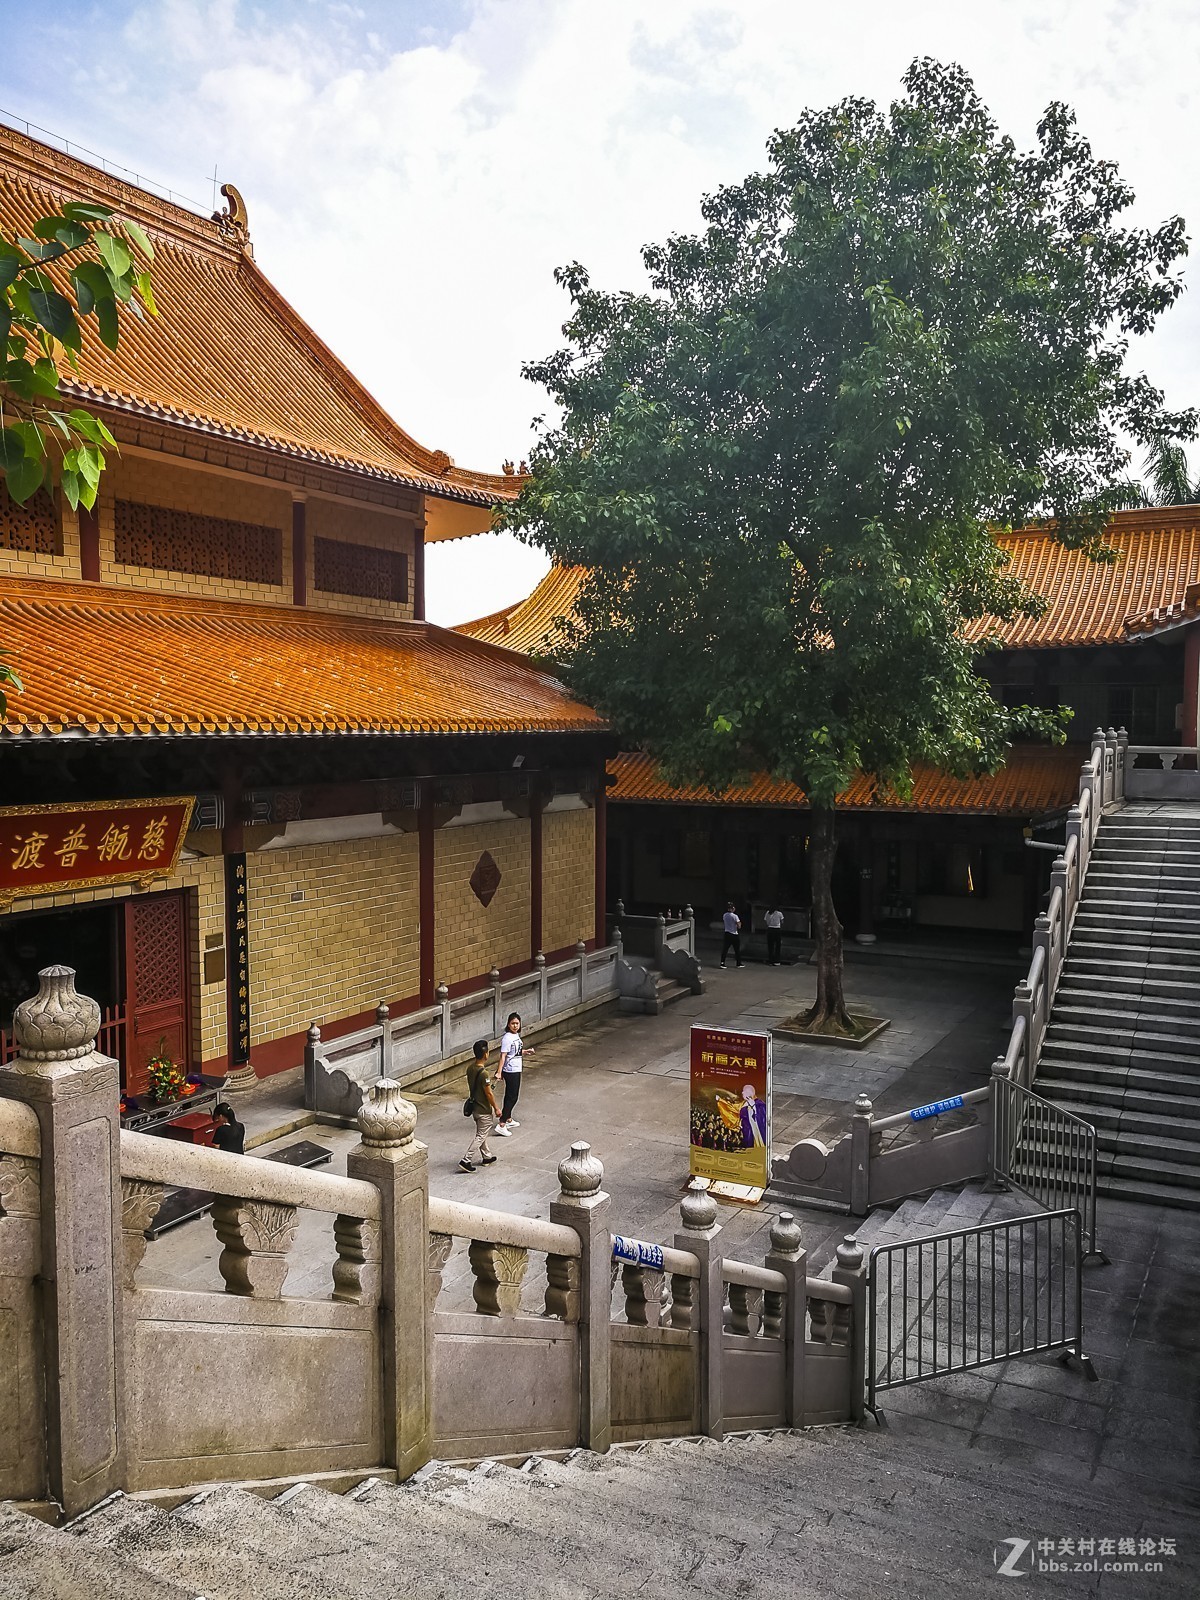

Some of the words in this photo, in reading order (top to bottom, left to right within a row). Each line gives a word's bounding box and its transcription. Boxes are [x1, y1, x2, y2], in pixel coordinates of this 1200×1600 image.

[10, 815, 169, 870] 慈航普渡
[701, 1051, 757, 1070] 祈福大典
